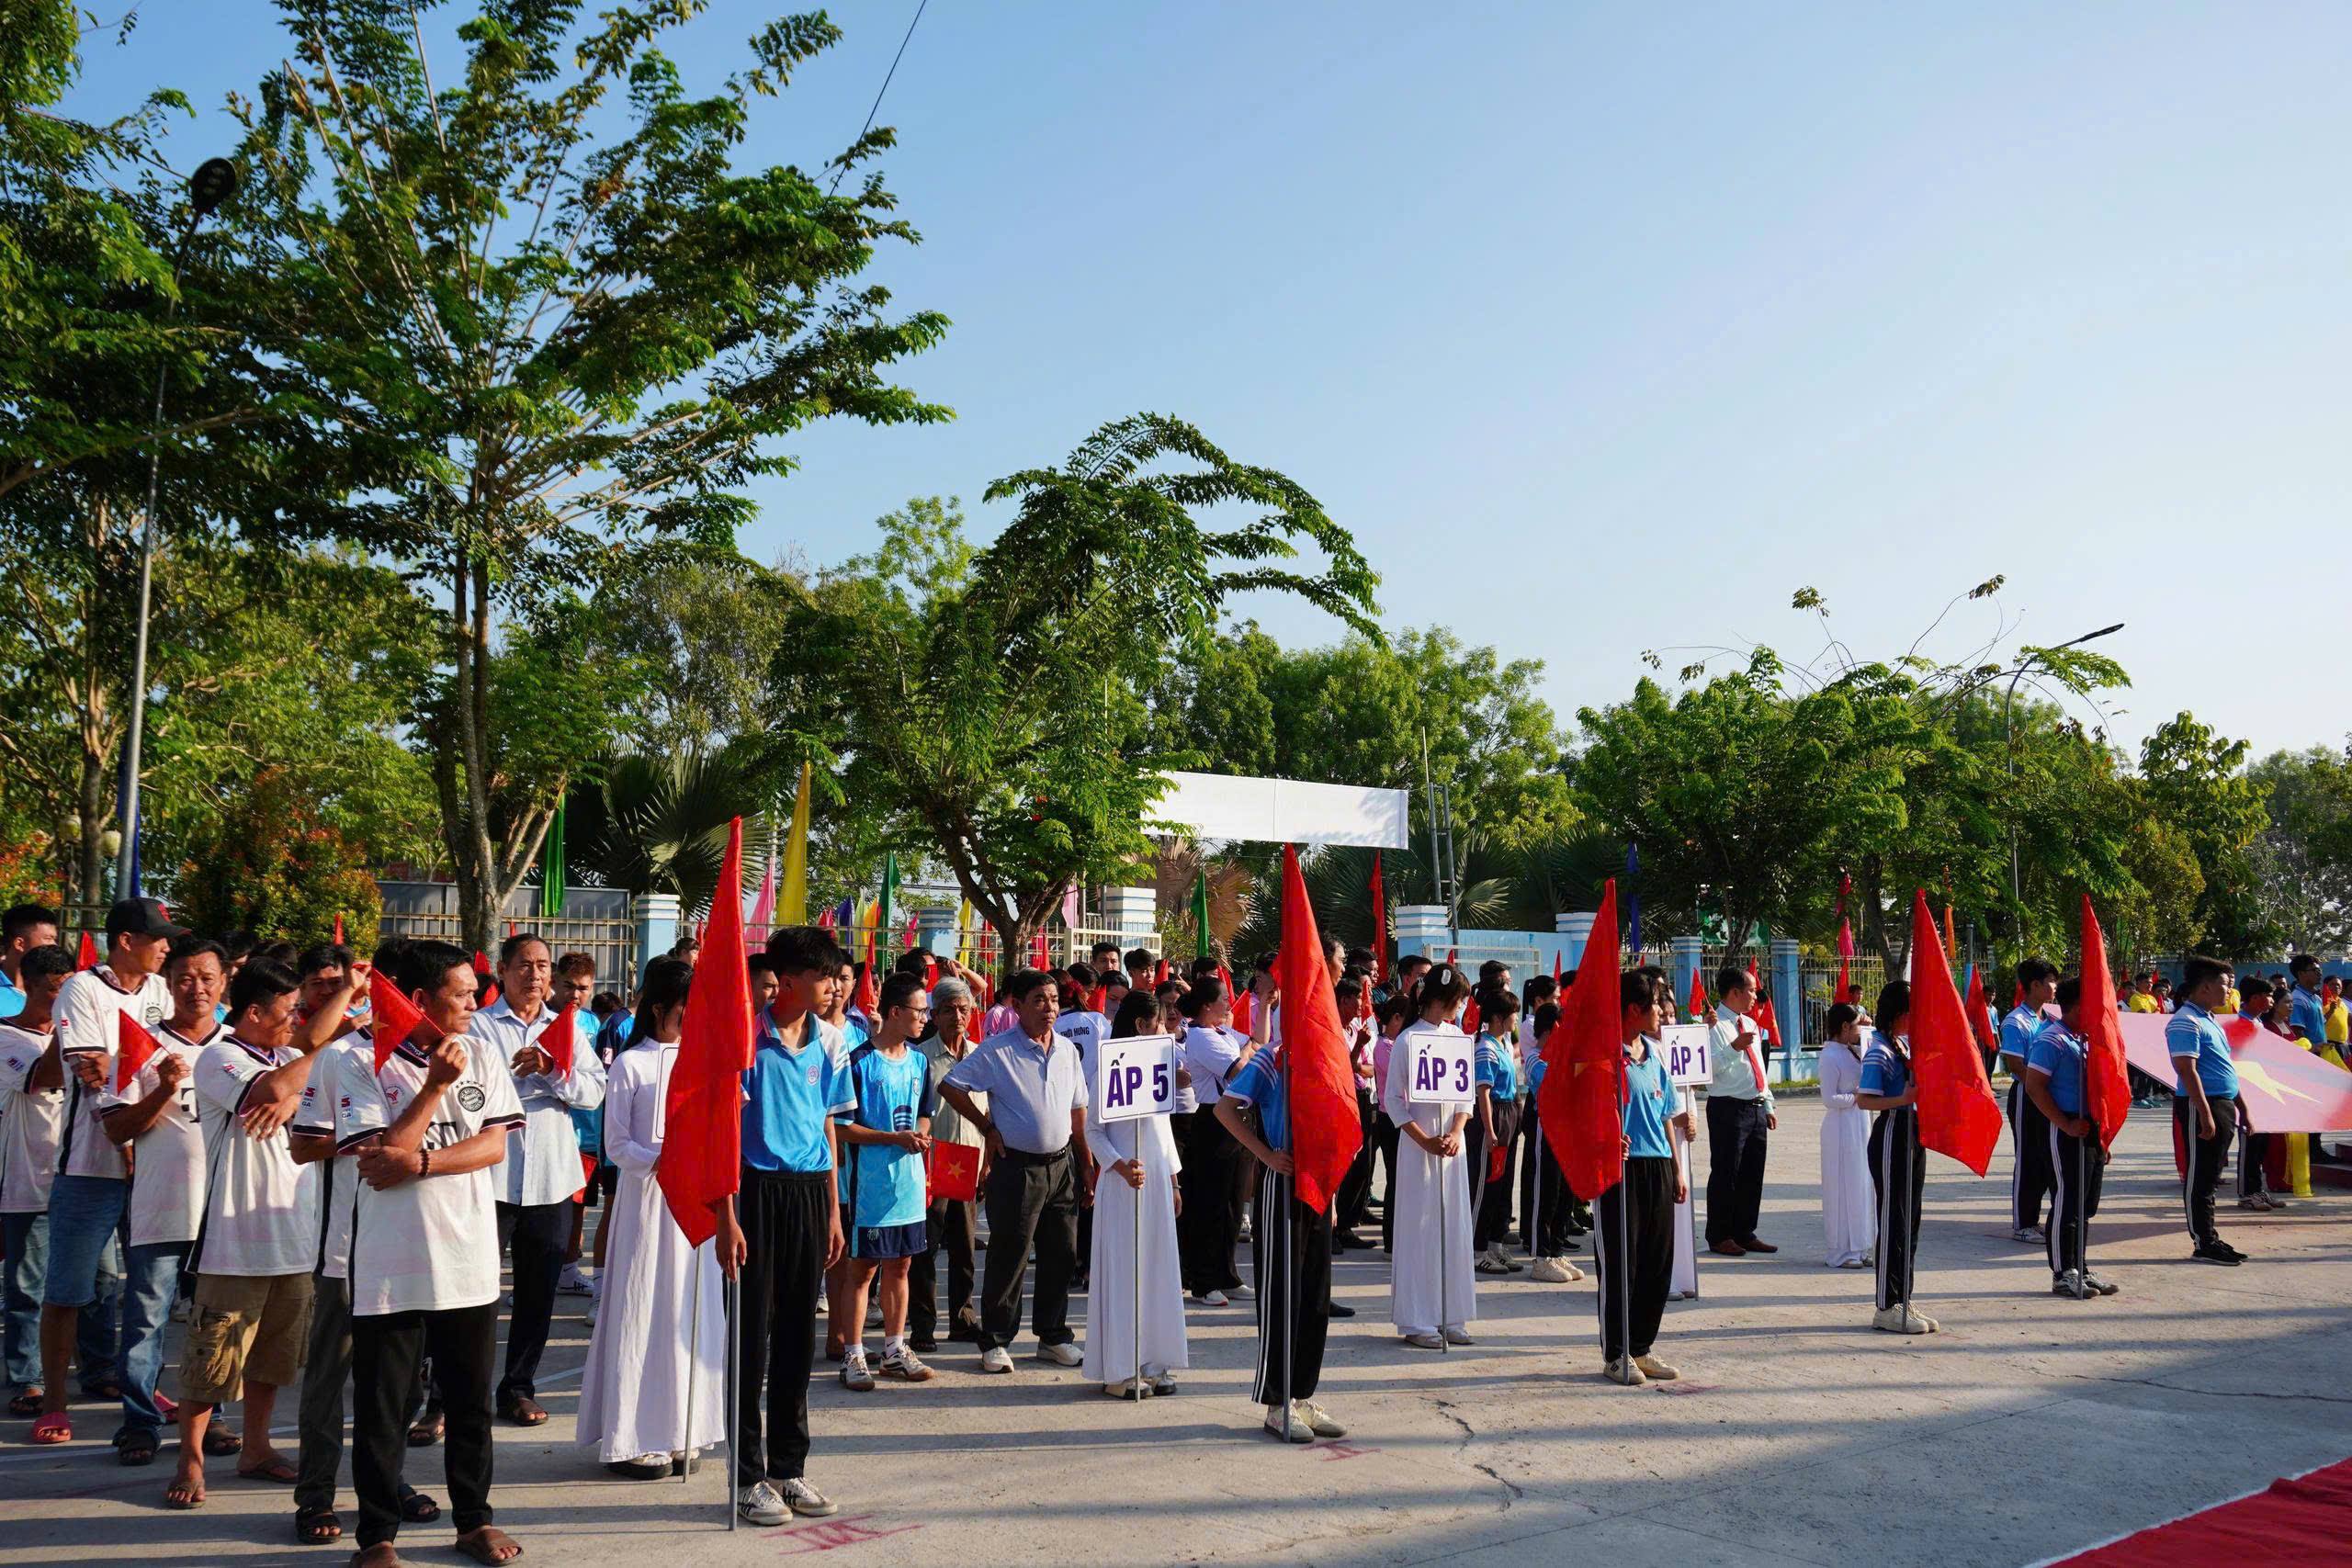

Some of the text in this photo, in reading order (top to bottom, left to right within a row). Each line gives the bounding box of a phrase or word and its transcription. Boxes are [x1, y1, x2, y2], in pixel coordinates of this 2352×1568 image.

[1416, 1044, 1468, 1092] ẤP 3
[1671, 1035, 1705, 1076] ẤP 1
[1106, 1053, 1169, 1108] ẤP 5
